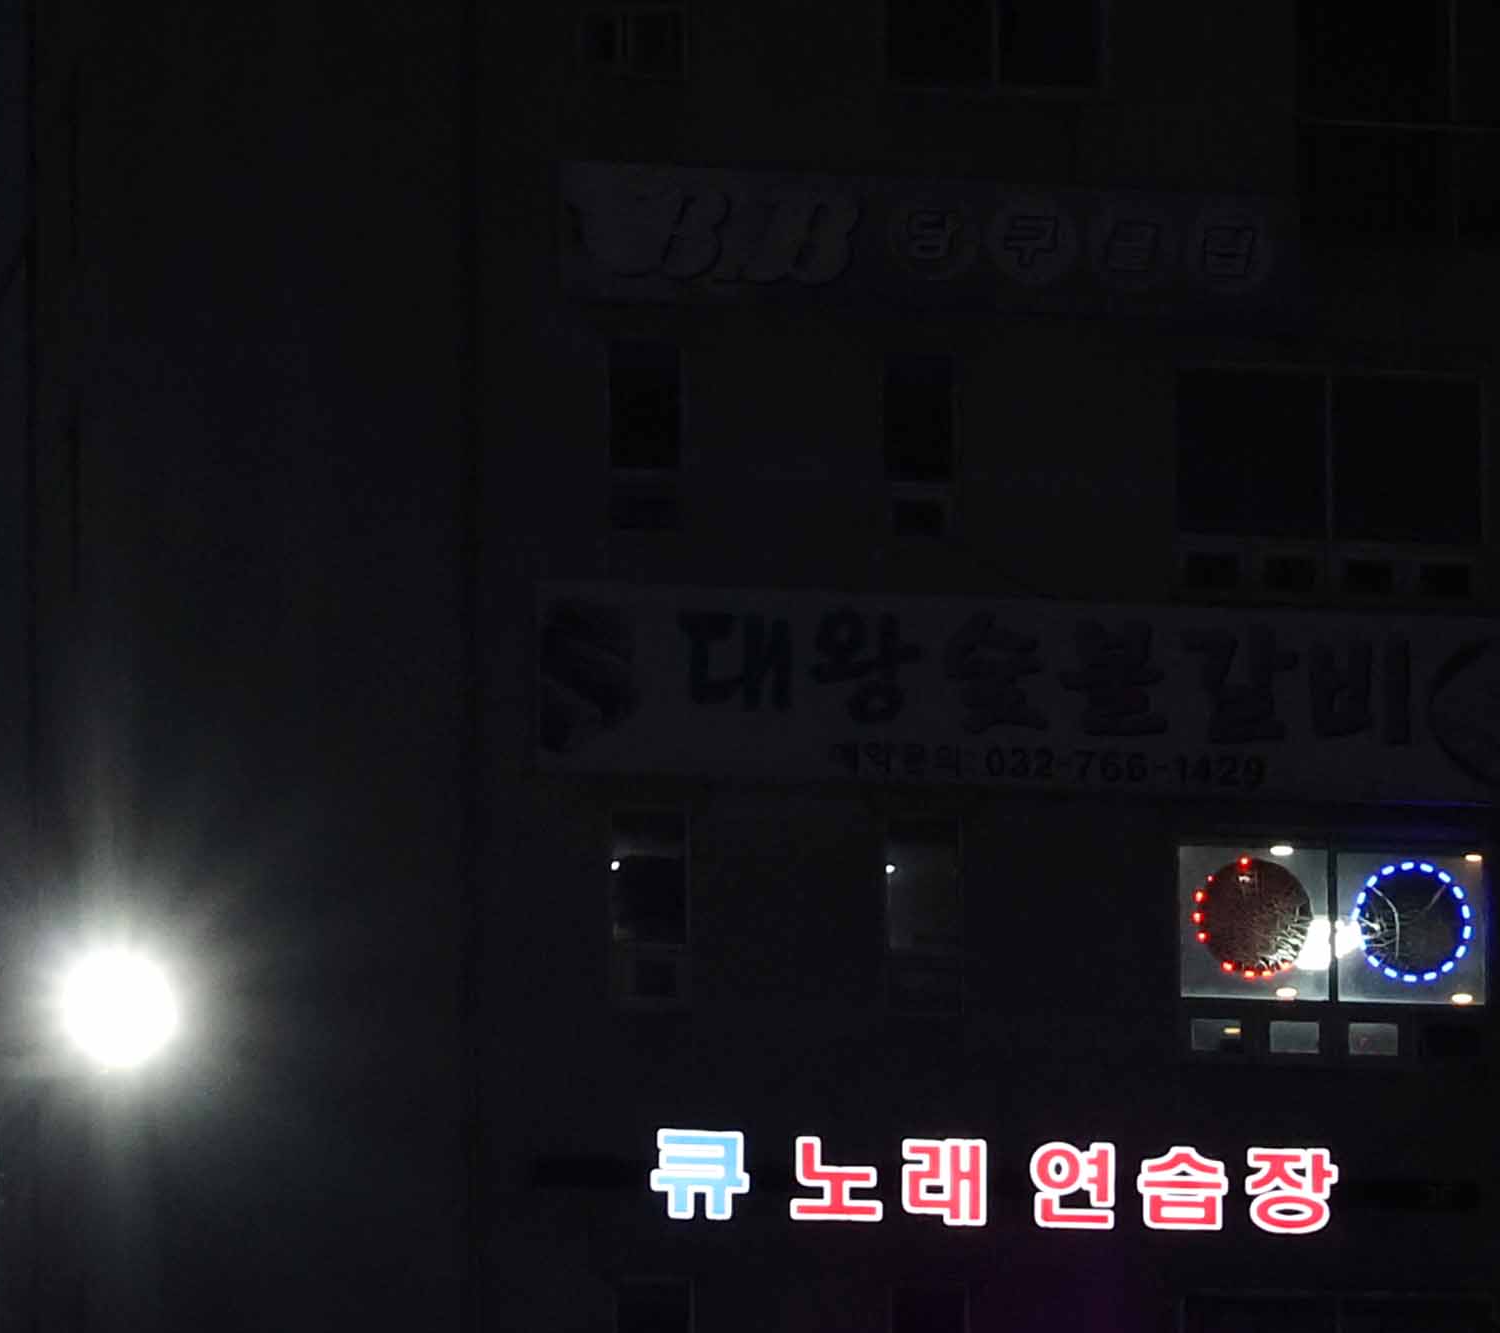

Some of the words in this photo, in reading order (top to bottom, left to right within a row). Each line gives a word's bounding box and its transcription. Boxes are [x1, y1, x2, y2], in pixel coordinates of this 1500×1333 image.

[679, 606, 1411, 747] 대왕숯불갈비
[651, 1128, 749, 1219] 큐
[790, 1136, 988, 1227] 노래
[1030, 1142, 1338, 1233] 연습장
